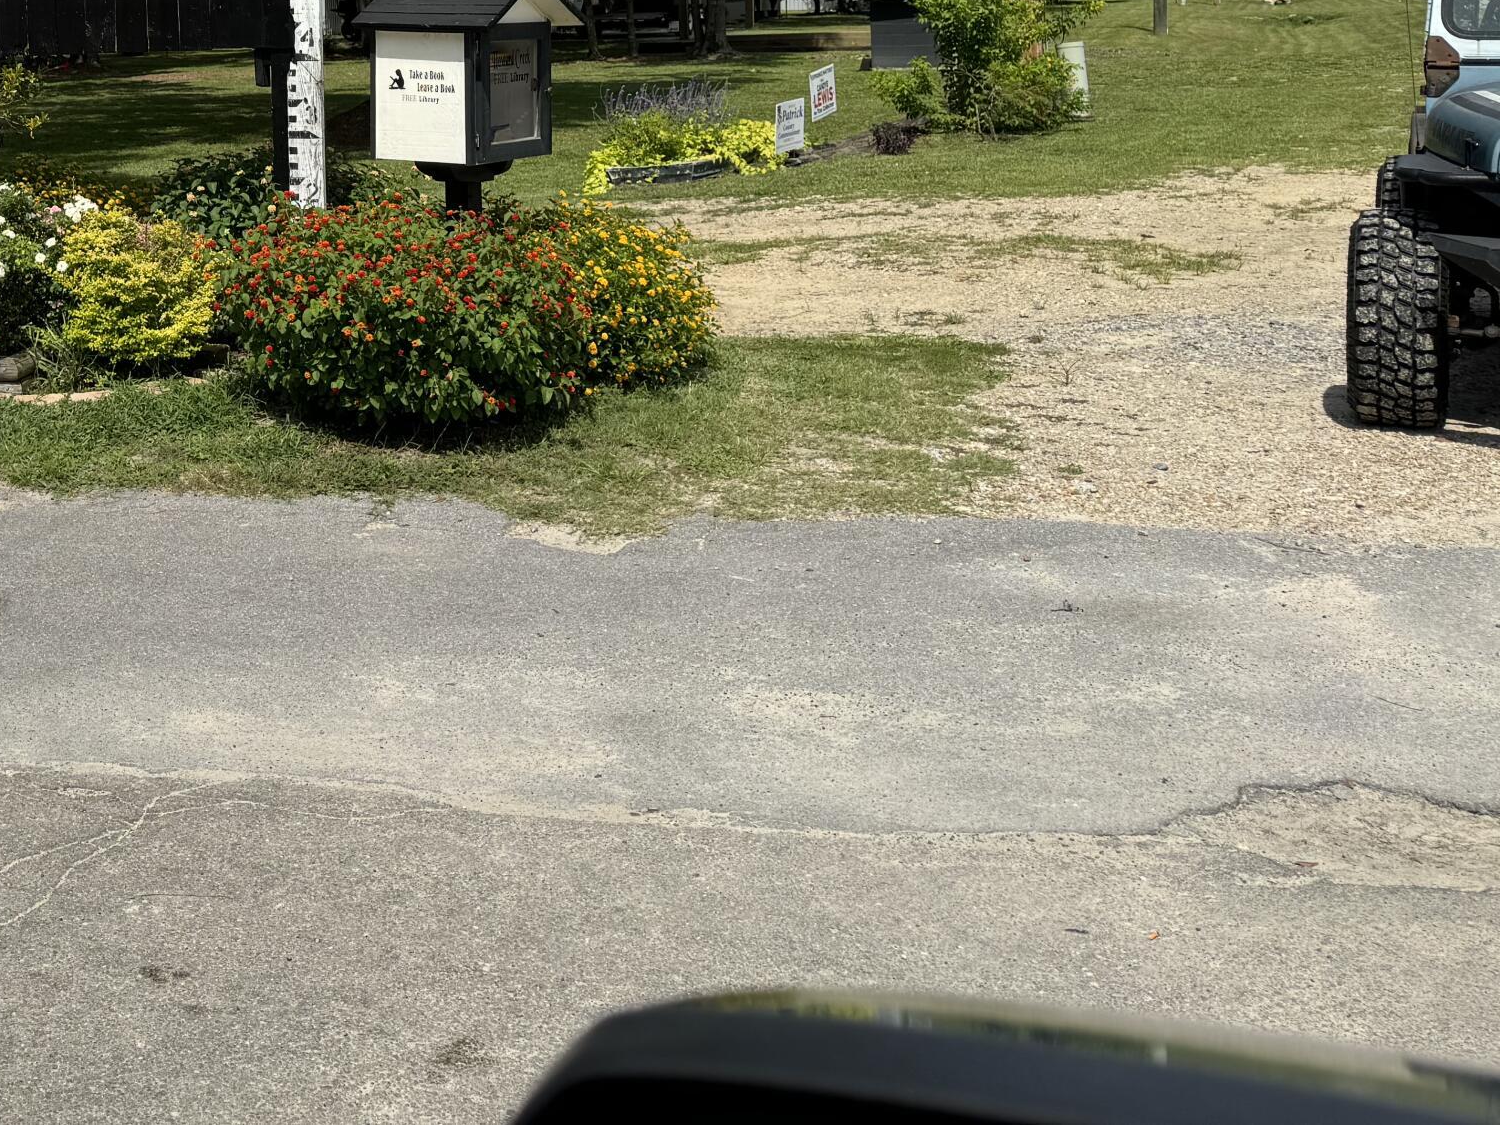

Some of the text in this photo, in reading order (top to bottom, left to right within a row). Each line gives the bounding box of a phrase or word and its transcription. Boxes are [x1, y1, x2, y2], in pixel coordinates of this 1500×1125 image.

[299, 27, 314, 47] 4
[409, 69, 423, 80] Take
[429, 70, 445, 81] Book
[510, 71, 529, 84] Library
[417, 83, 433, 93] Leave
[440, 84, 456, 94] Book
[401, 94, 440, 105] FREE Library
[813, 86, 834, 108] LEWIS
[782, 105, 803, 122] Patrick
